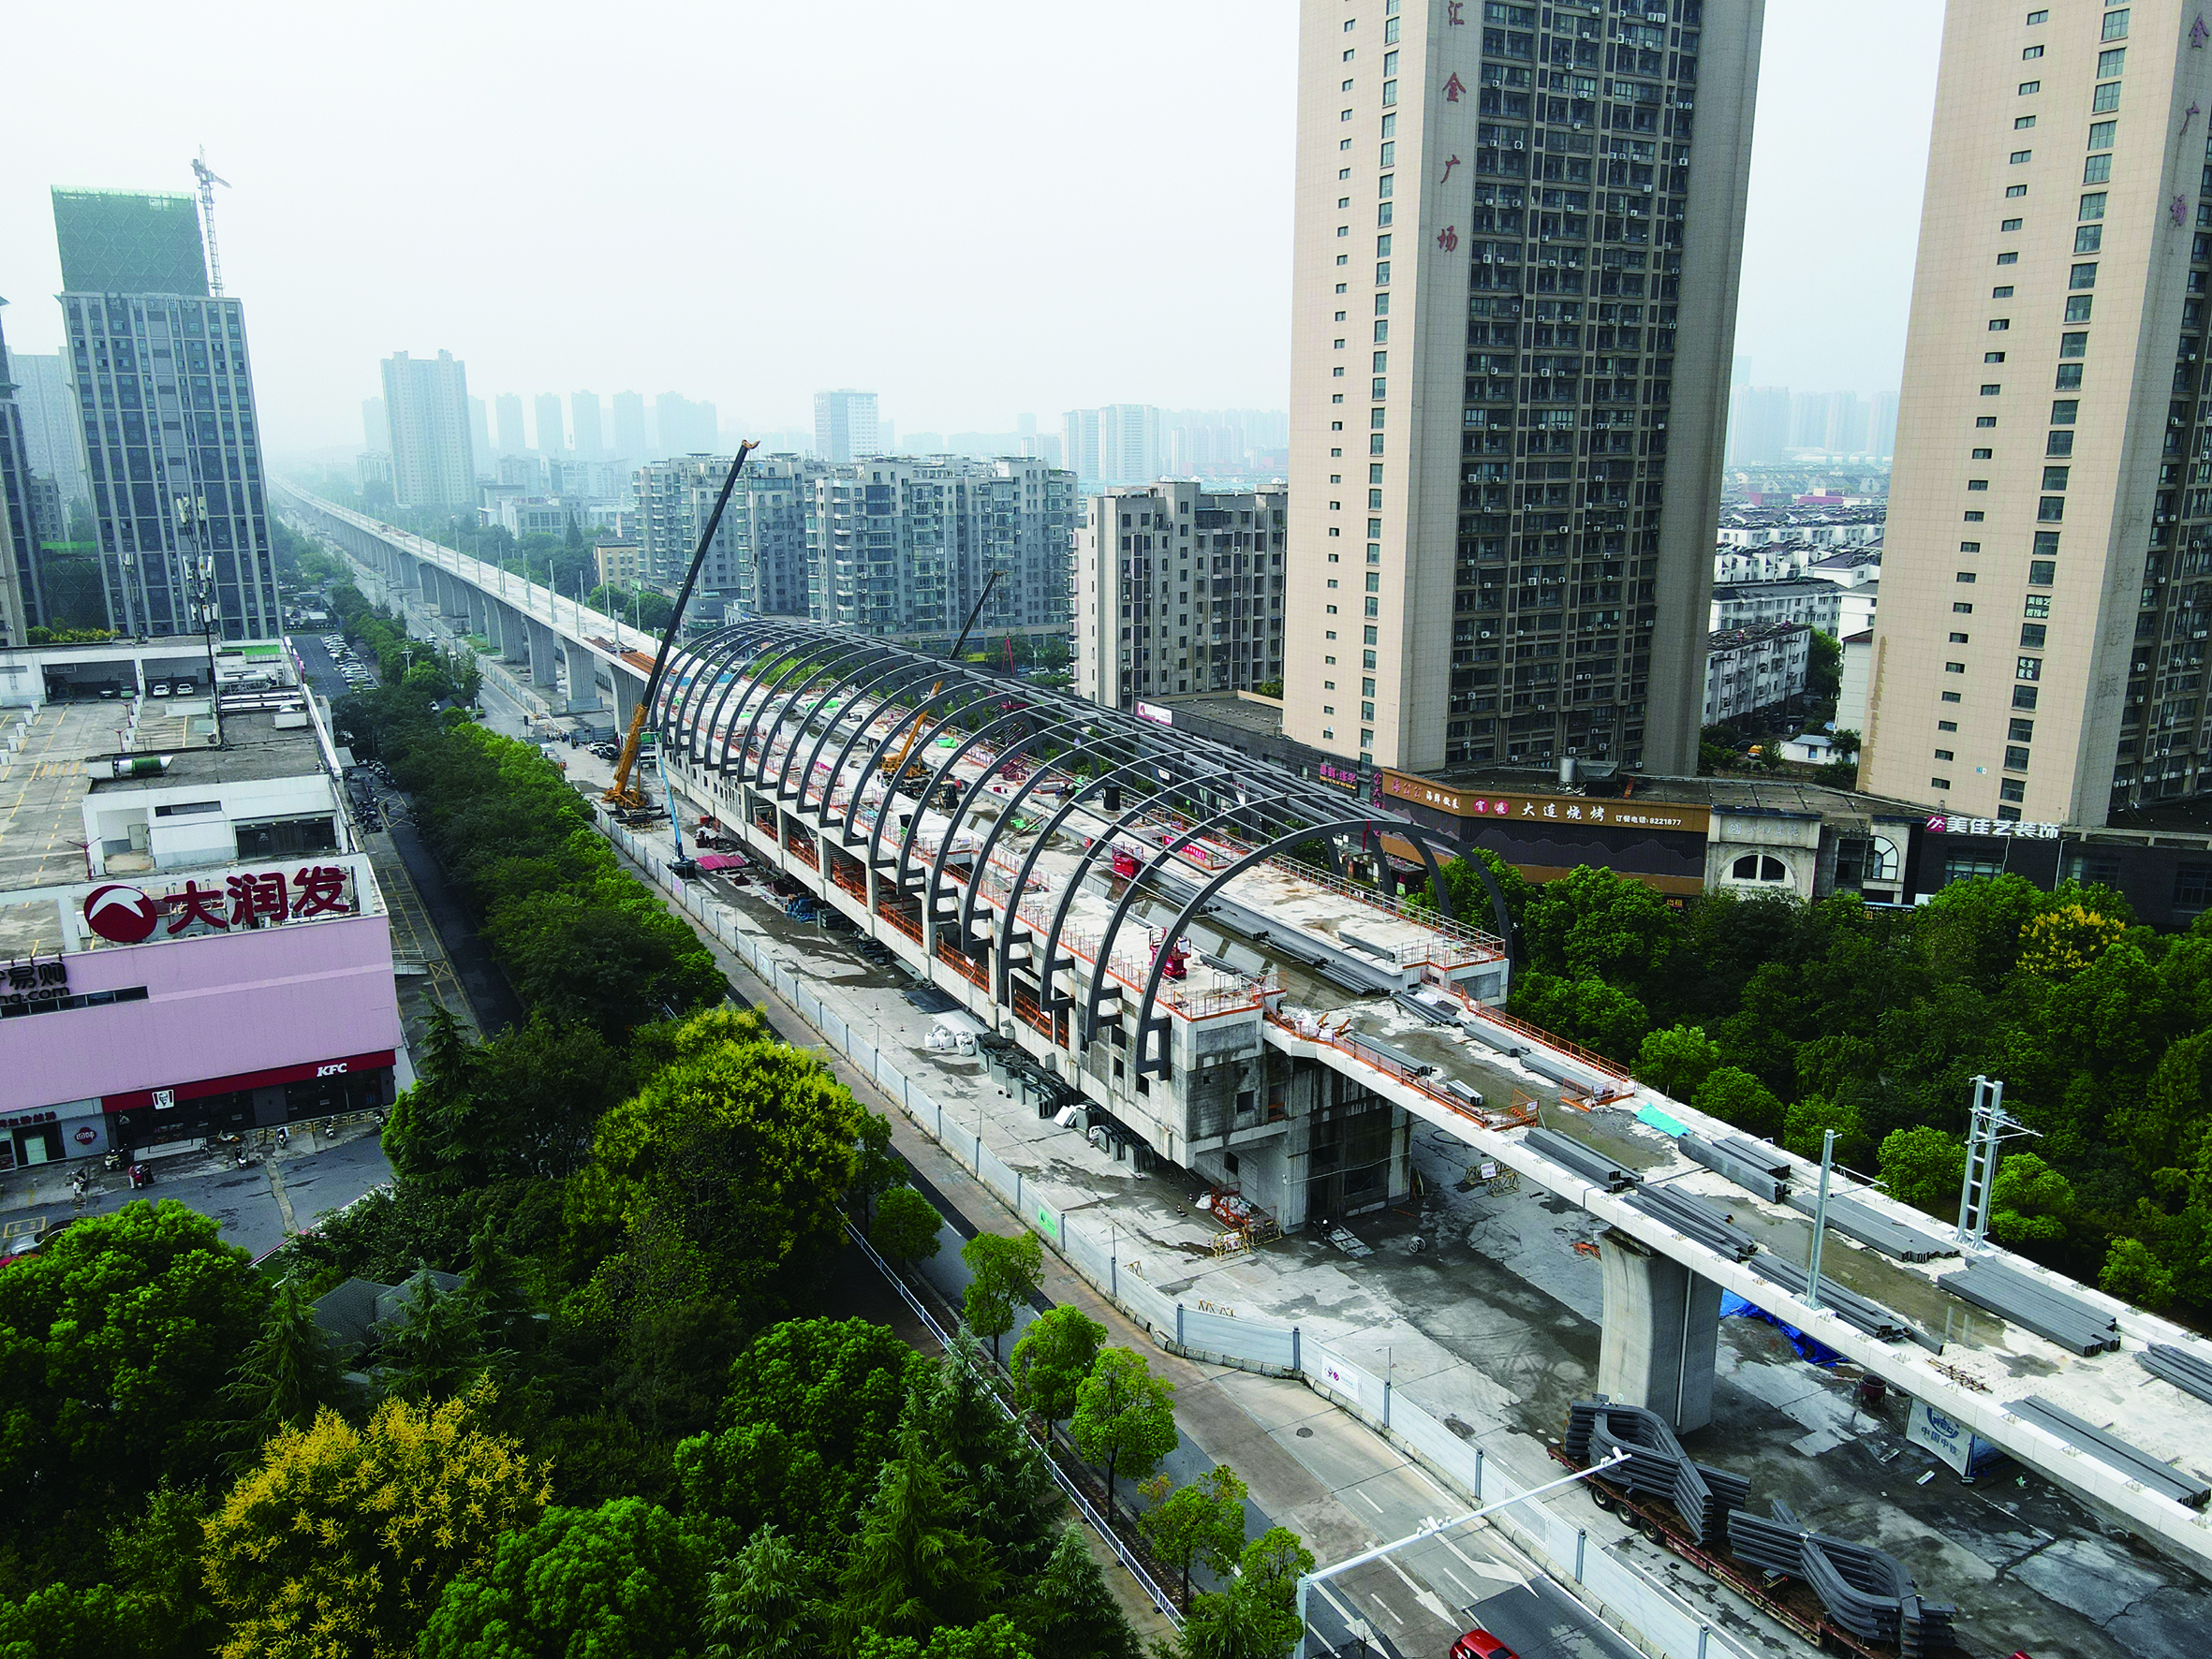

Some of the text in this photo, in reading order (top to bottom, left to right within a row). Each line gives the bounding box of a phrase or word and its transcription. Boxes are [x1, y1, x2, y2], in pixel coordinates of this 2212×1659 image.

[1437, 0, 1467, 253] 汇金广场
[1474, 799, 1507, 815] 宵夜
[1521, 801, 1605, 822] 大连烧烤
[1945, 816, 2059, 839] 美佳艺装饰
[164, 865, 350, 935] 大润发
[0, 962, 67, 991] 易购
[317, 1062, 347, 1078] KFC
[1921, 1426, 1957, 1457] 中国中铁
